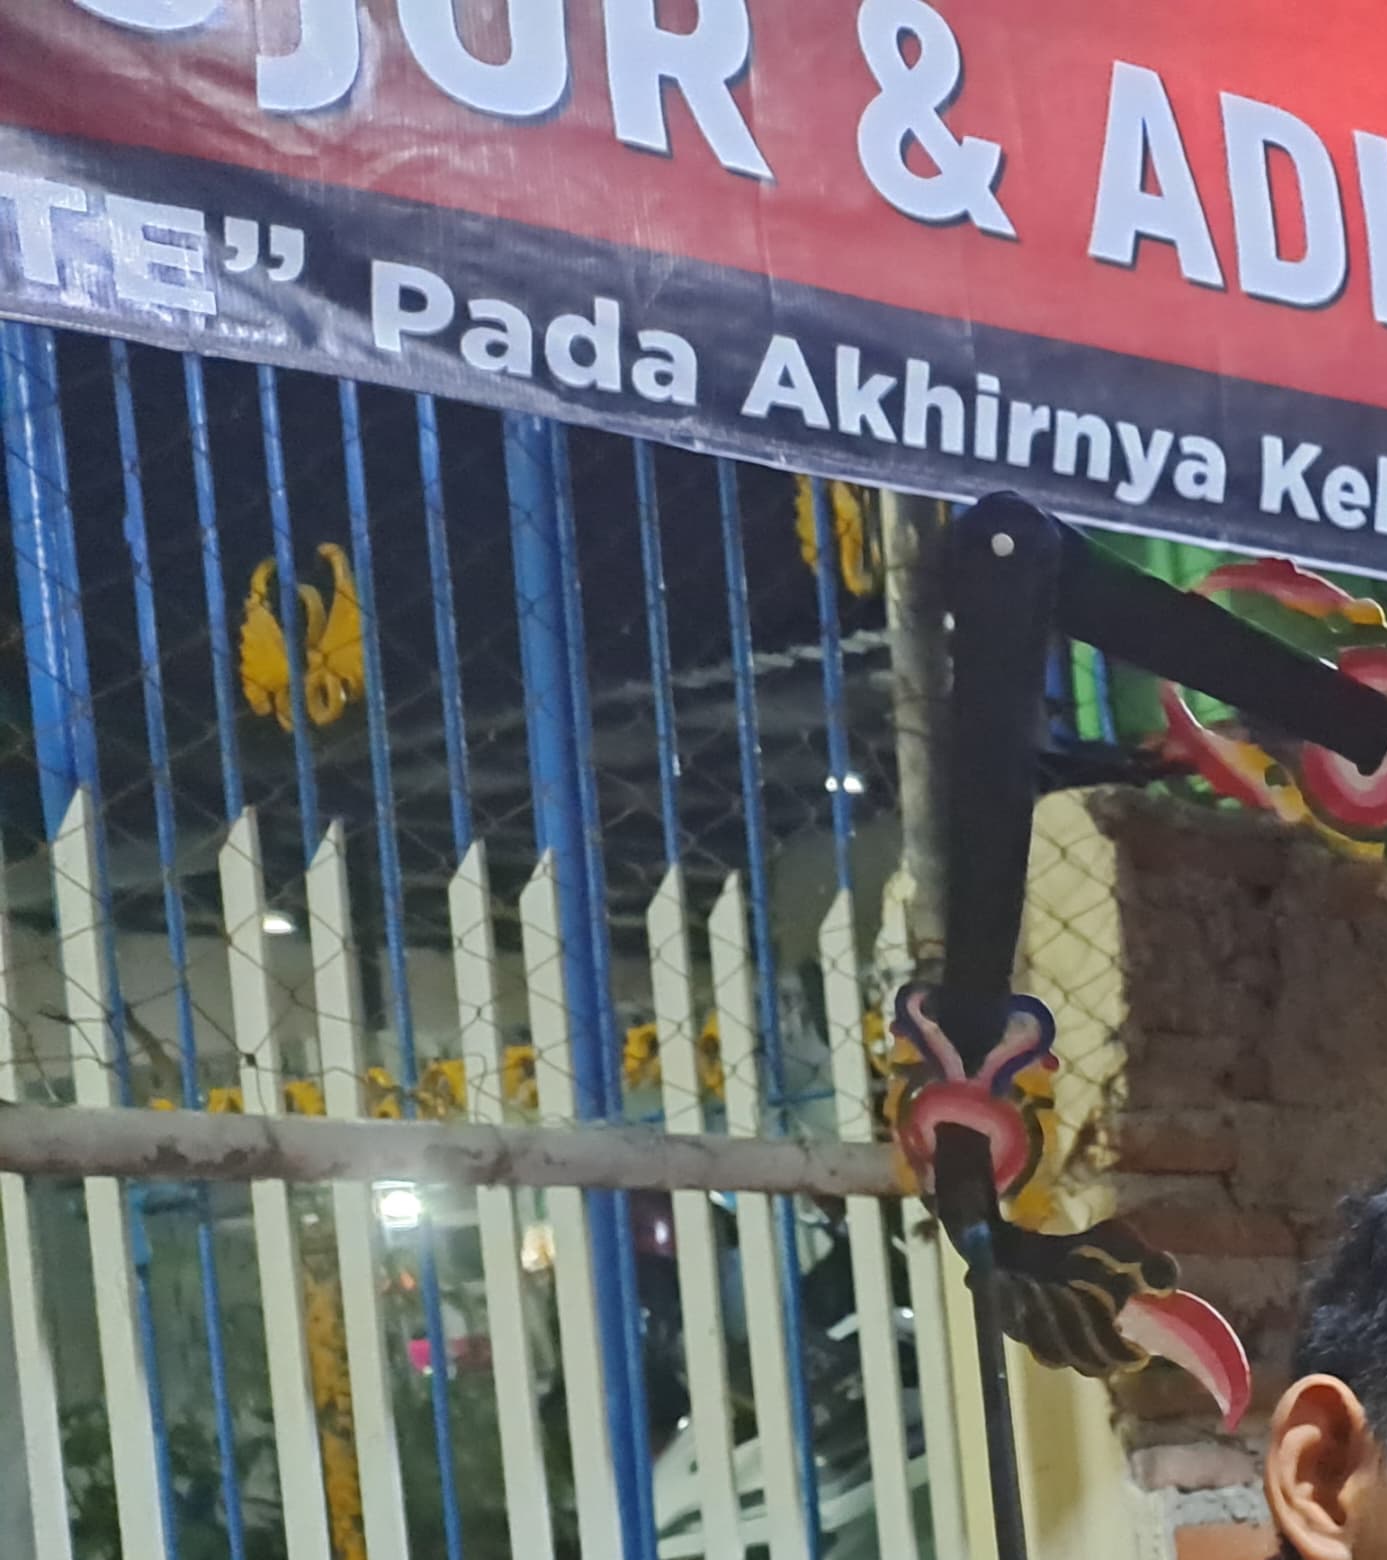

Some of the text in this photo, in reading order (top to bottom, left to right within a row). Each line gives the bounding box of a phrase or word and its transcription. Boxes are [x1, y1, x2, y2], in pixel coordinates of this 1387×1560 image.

[52, 0, 775, 179] JUR
[857, 0, 1018, 238] &
[370, 259, 698, 406] Pada
[742, 334, 1226, 506] Akhirnya
